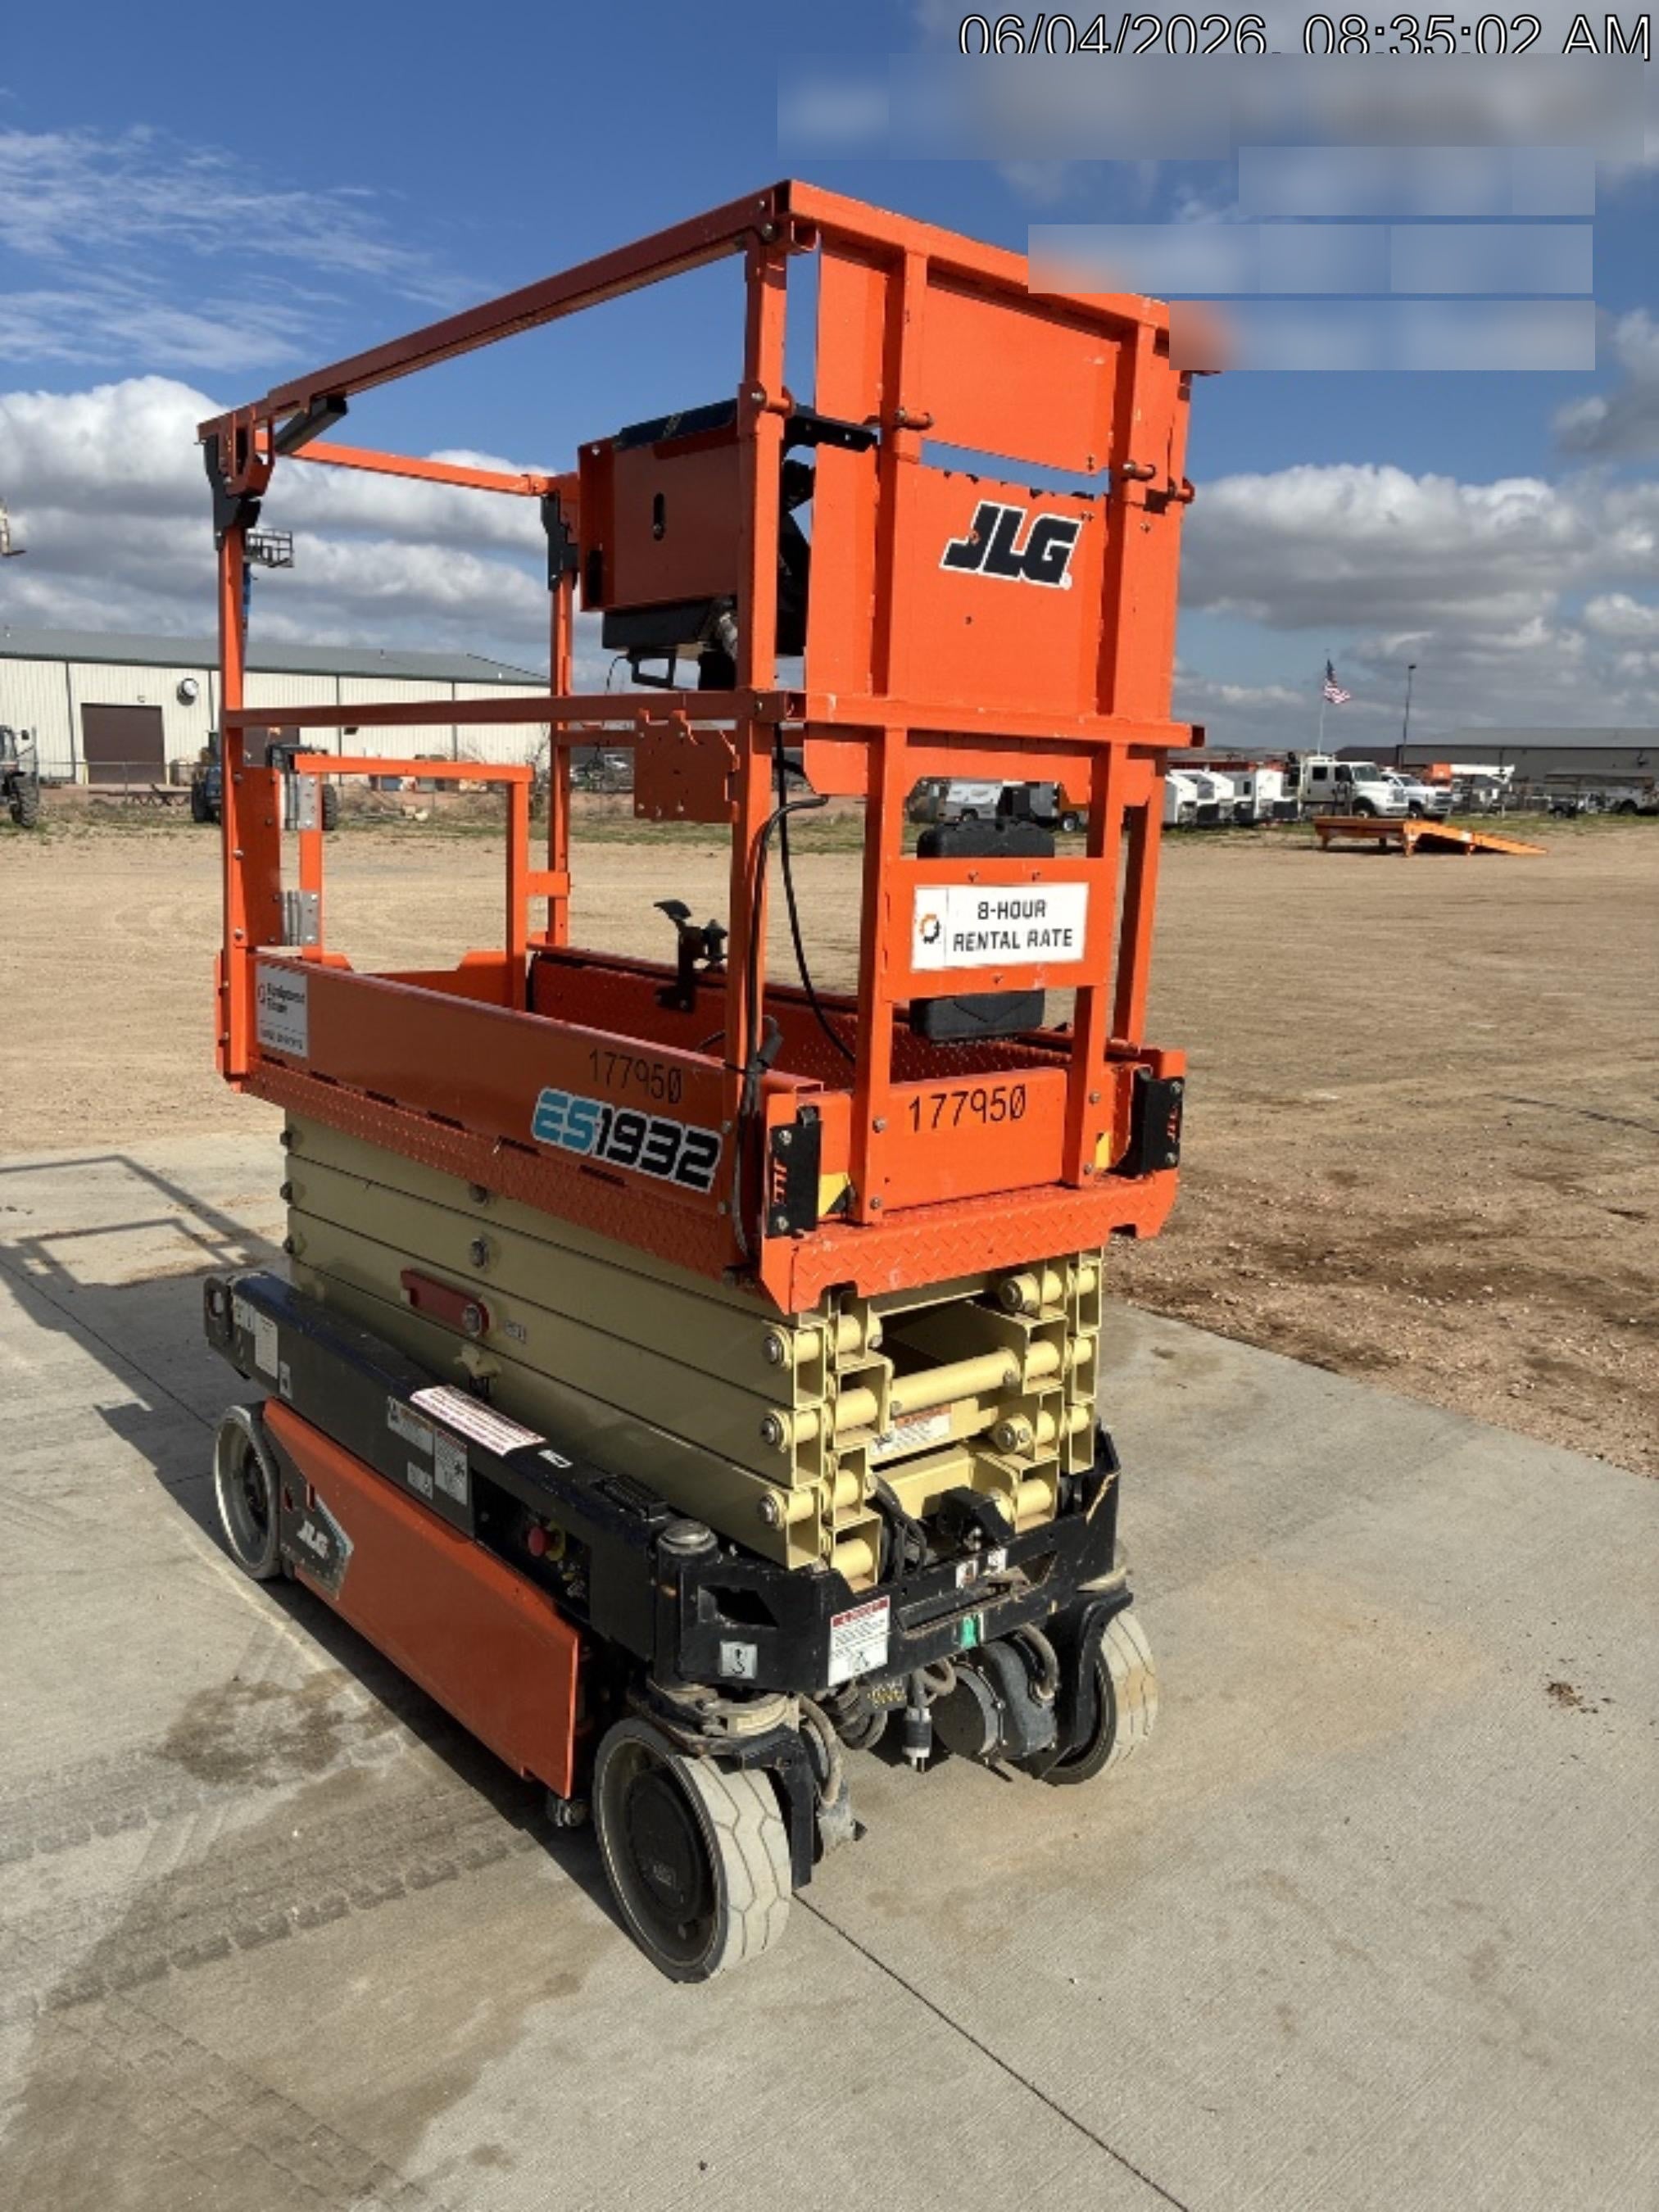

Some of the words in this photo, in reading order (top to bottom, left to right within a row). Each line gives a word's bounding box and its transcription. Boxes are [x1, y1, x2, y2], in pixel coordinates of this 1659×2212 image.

[939, 500, 1083, 589] JLG
[977, 899, 1046, 920] 8-HOUR
[953, 931, 1021, 952] RENTAL
[1027, 928, 1073, 948] RATE
[589, 1048, 682, 1104] 177950
[909, 1083, 1026, 1134] 177950
[531, 1086, 723, 1194] ES1932
